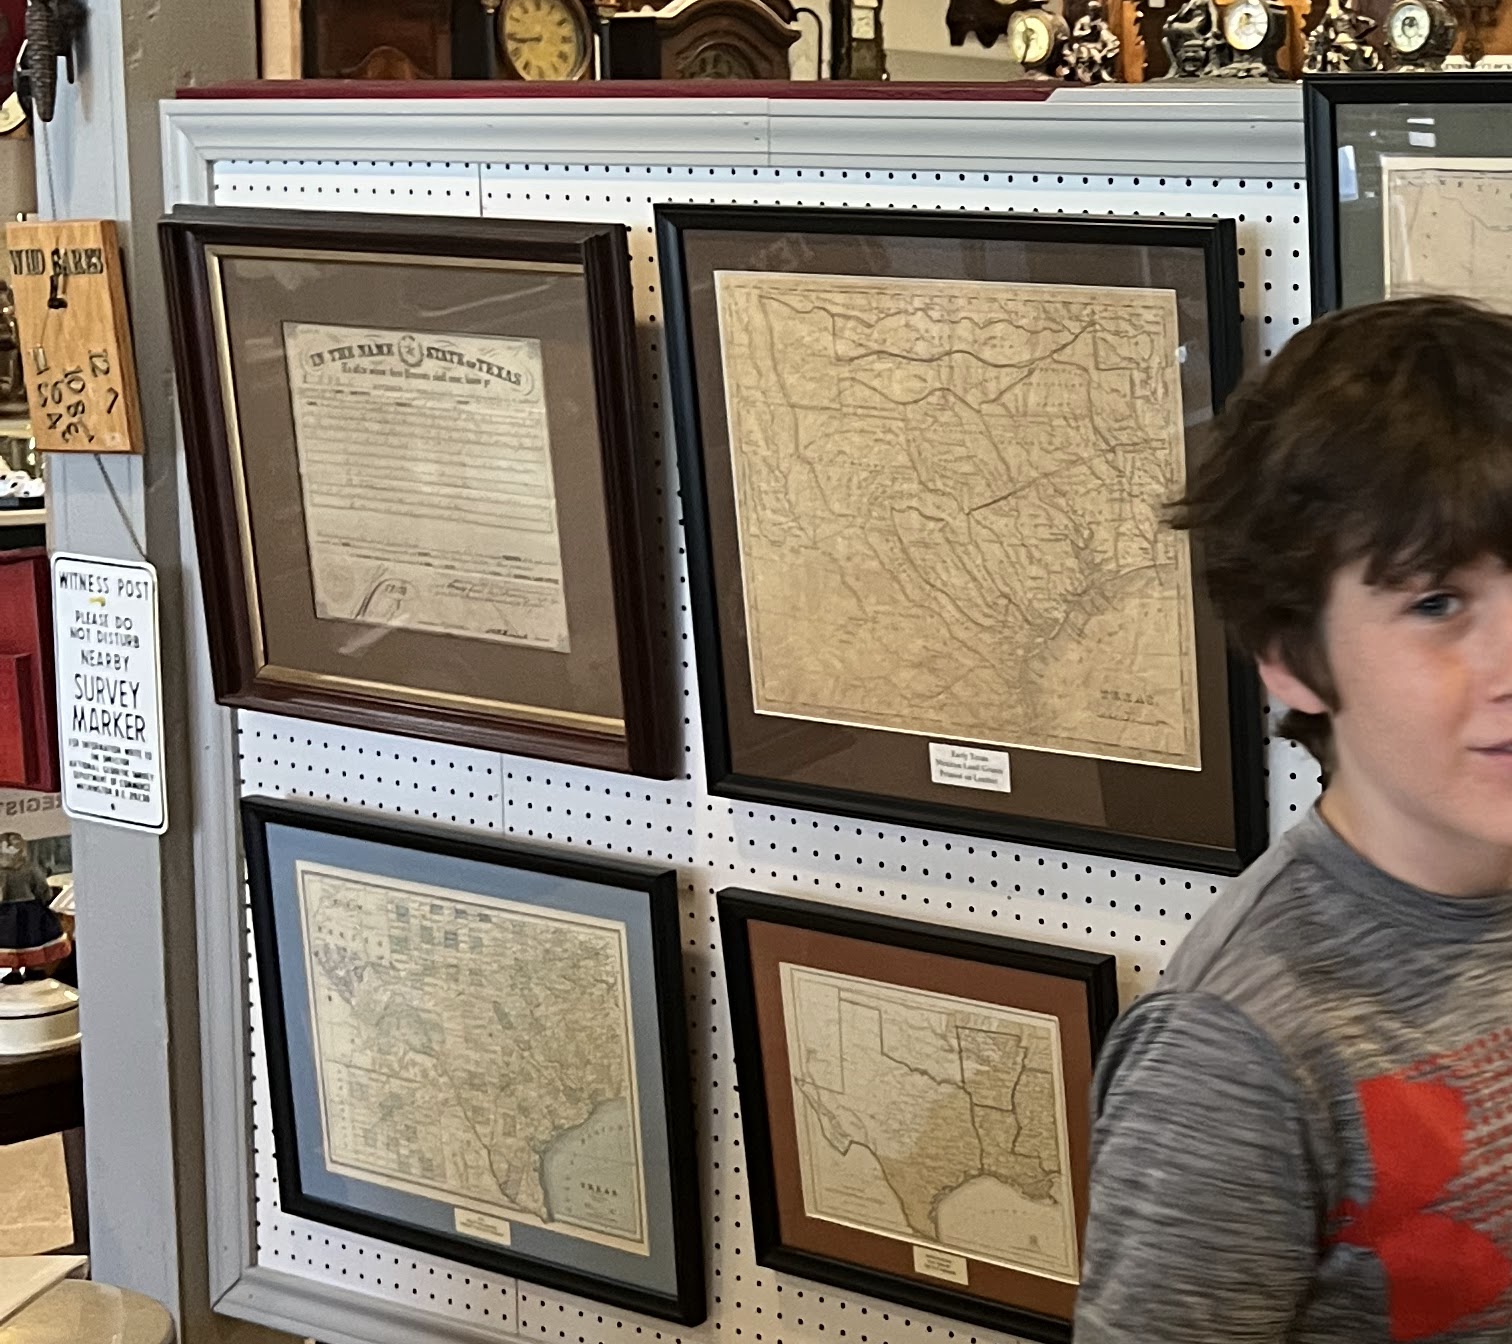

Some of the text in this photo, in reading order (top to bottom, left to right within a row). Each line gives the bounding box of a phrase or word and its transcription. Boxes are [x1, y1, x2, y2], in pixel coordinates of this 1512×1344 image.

[476, 358, 522, 386] TEXAS
[59, 571, 149, 601] WITNESS POST
[75, 610, 133, 631] PLEASE DO
[70, 627, 140, 649] NOT DISTURB
[80, 649, 130, 672] NEARBY
[74, 673, 140, 709] SURVEY
[72, 705, 146, 743] MARKER
